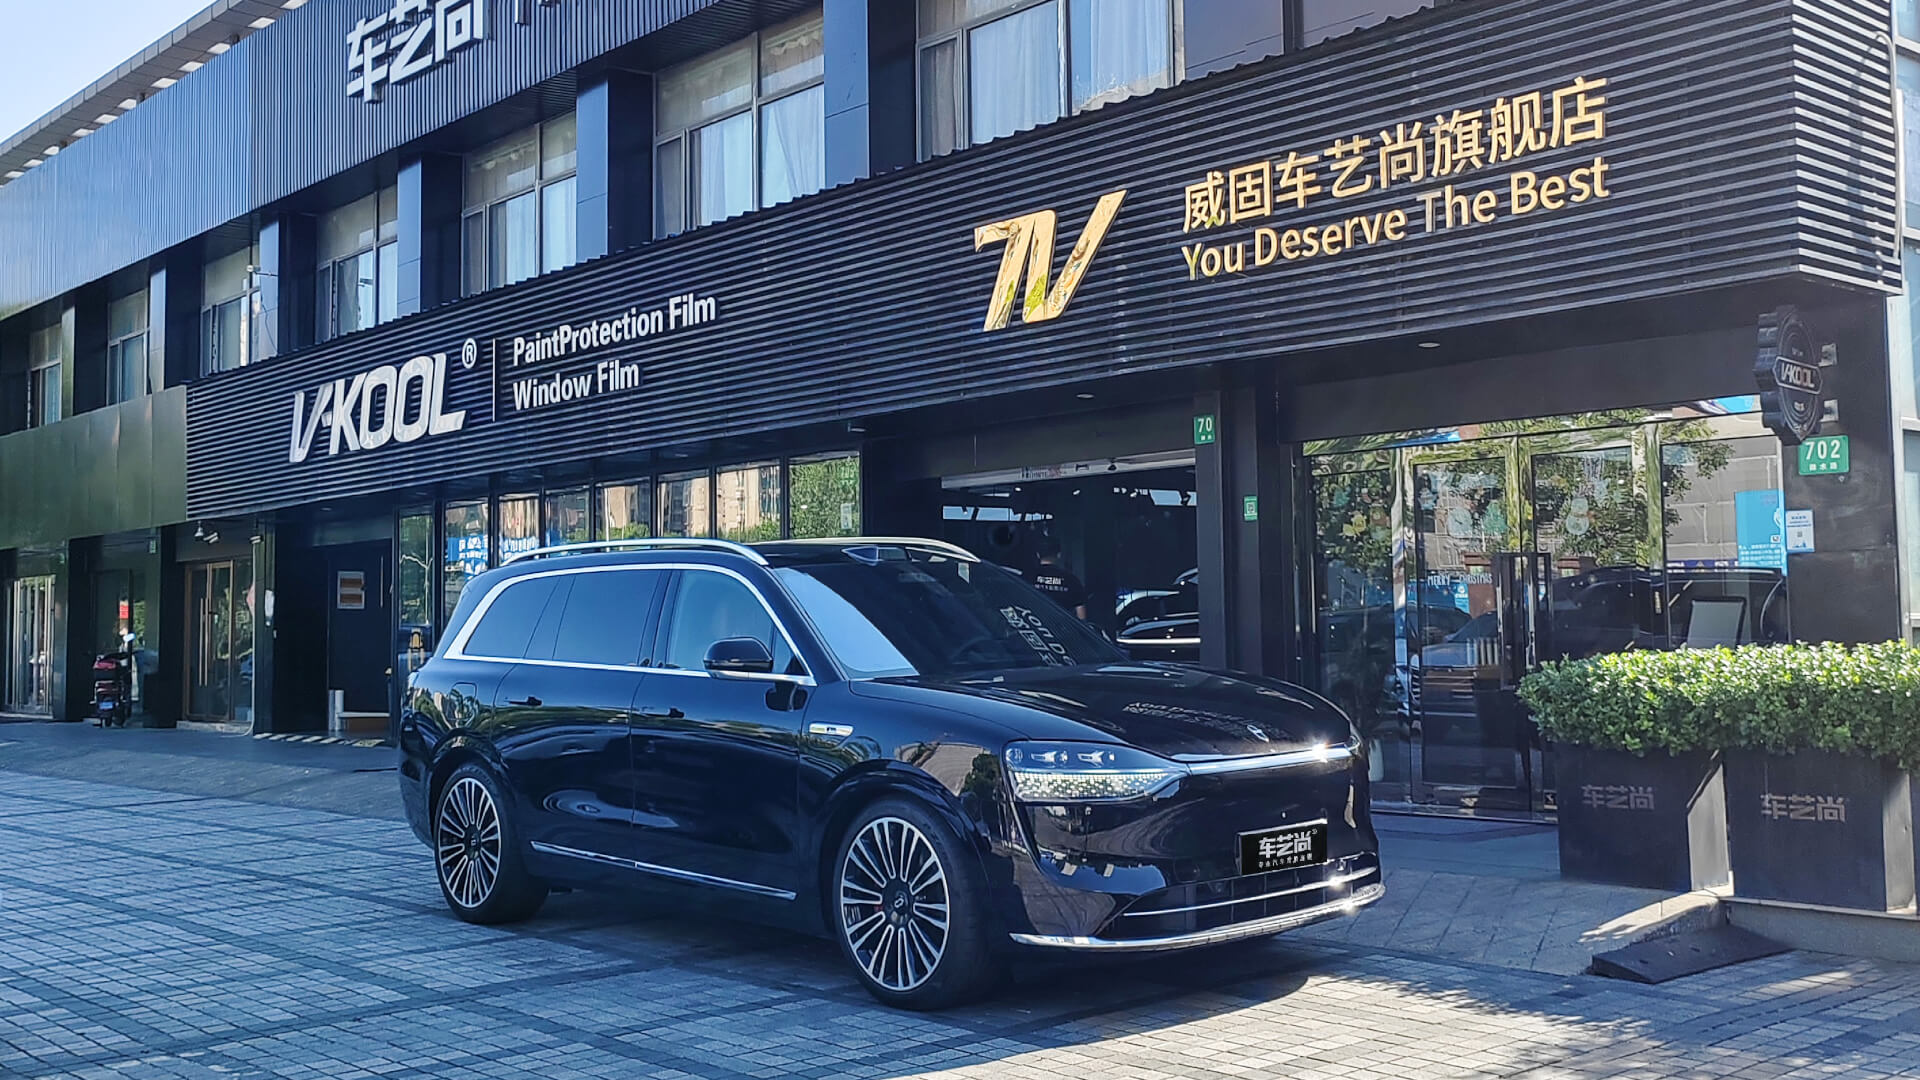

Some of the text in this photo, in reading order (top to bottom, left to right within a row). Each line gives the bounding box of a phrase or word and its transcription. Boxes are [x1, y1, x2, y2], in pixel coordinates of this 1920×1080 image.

[346, 0, 484, 102] 车艺尚
[1182, 76, 1609, 233] 威固车艺尚旗舰店
[1181, 156, 1610, 281] You Deserve The Best
[512, 292, 717, 367] PaintProtection Film
[512, 359, 640, 411] Window Film
[1805, 439, 1841, 460] 702
[1427, 574, 1451, 587] MERRY
[1581, 784, 1655, 810] 车艺尚
[1760, 793, 1846, 822] 车艺尚
[1258, 830, 1312, 859] 车艺尚
